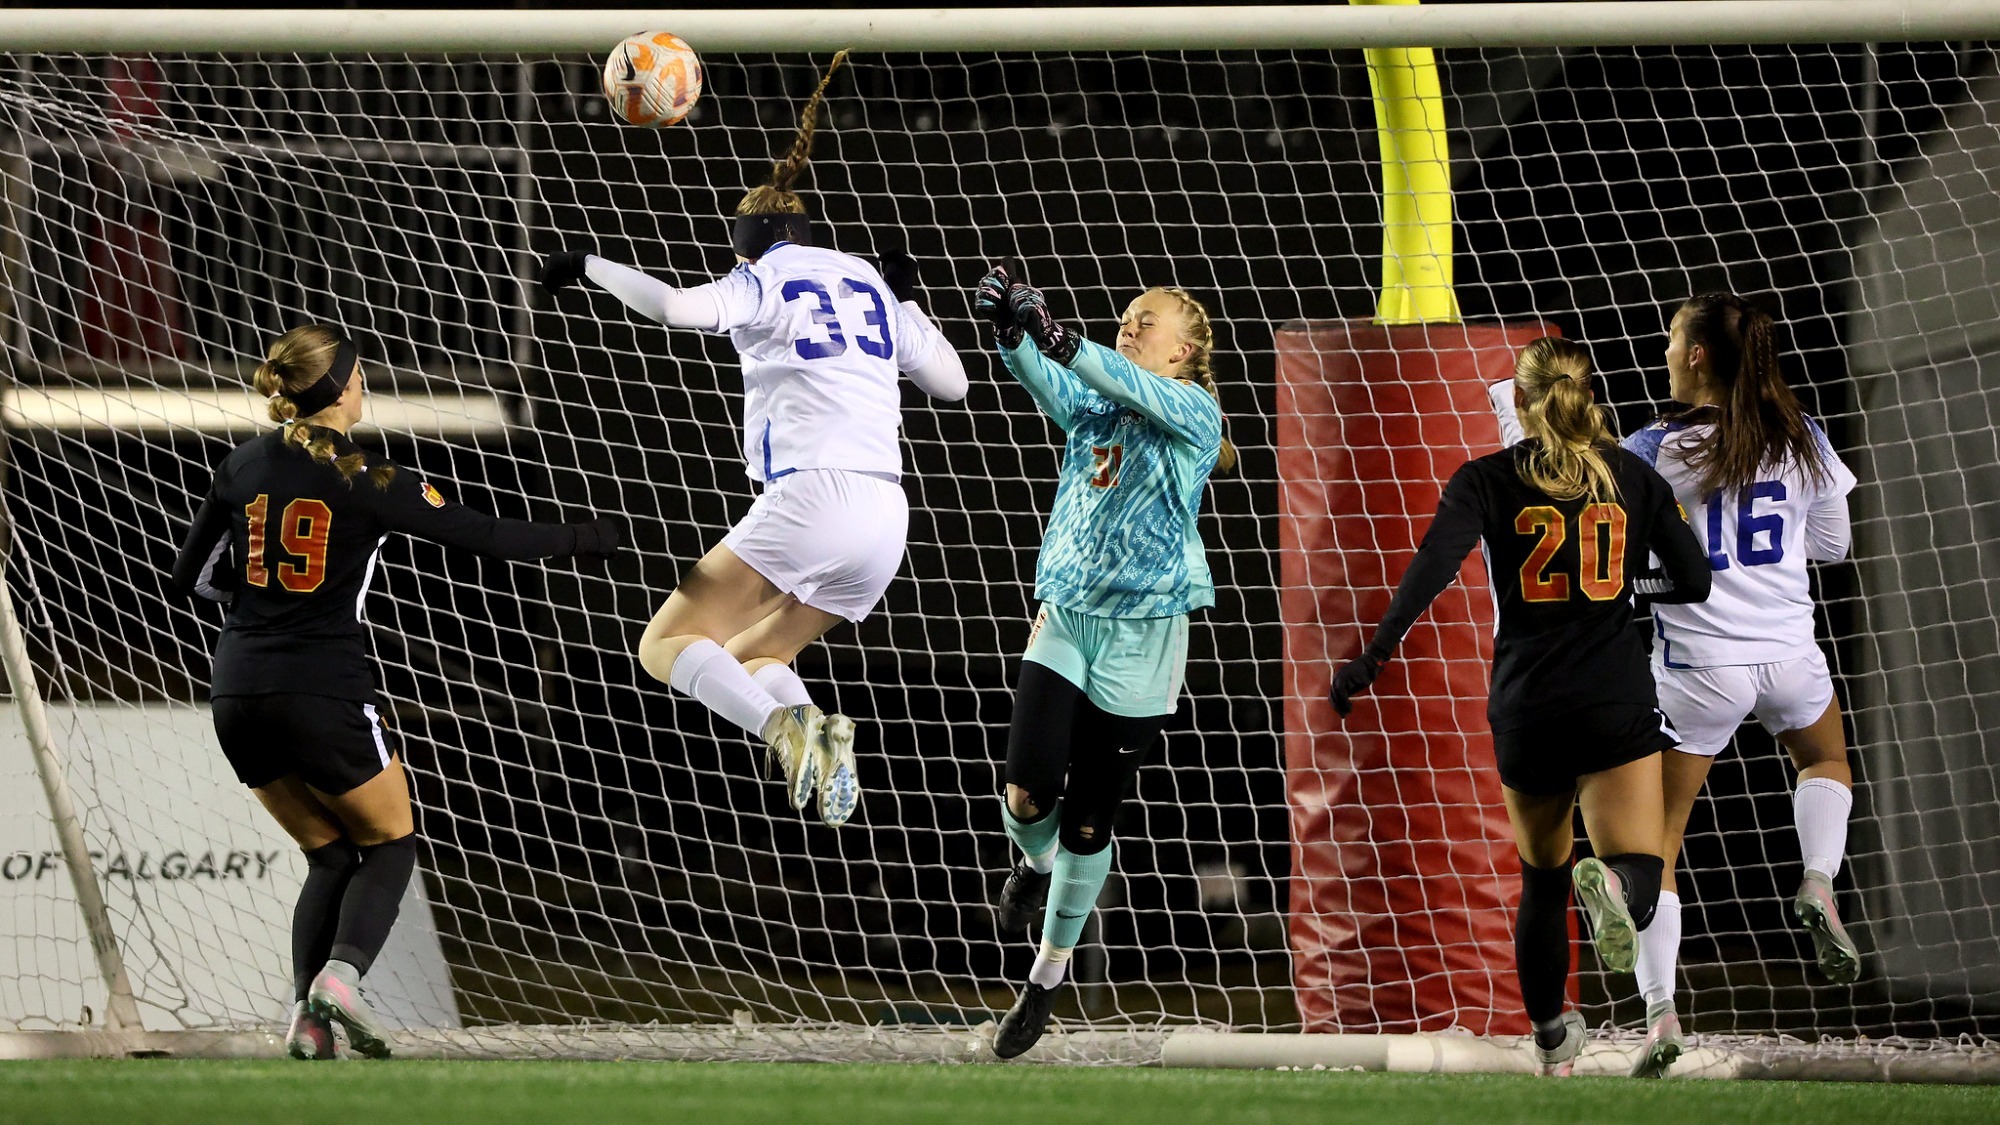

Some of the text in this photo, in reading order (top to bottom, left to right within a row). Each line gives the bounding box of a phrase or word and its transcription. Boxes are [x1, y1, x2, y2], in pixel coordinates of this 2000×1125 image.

[781, 277, 894, 361] 33
[245, 493, 333, 592] 19
[1514, 502, 1627, 602] 20
[1701, 480, 1787, 571] 16
[2, 850, 63, 880] OF
